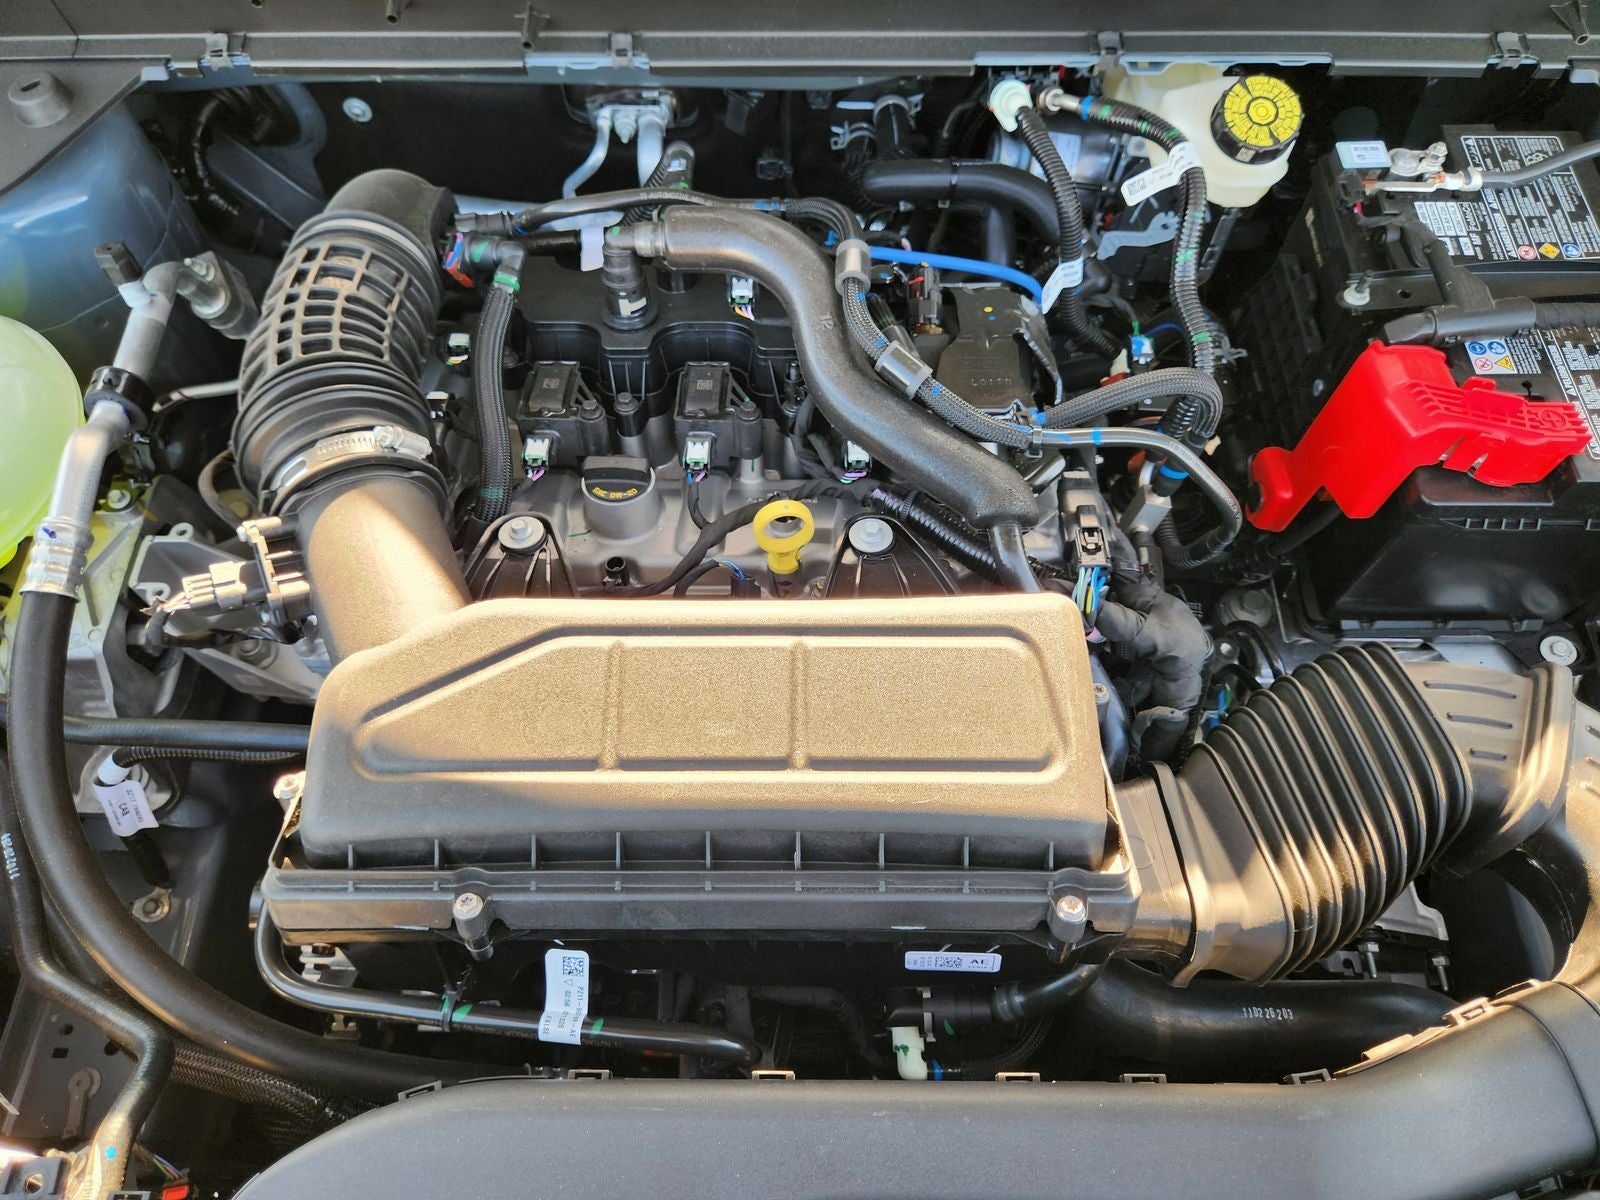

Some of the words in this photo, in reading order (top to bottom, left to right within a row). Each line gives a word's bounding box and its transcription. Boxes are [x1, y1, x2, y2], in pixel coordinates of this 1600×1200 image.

[1461, 203, 1477, 229] FoMoCo
[592, 487, 608, 496] SAE
[610, 488, 638, 498] 0W-20
